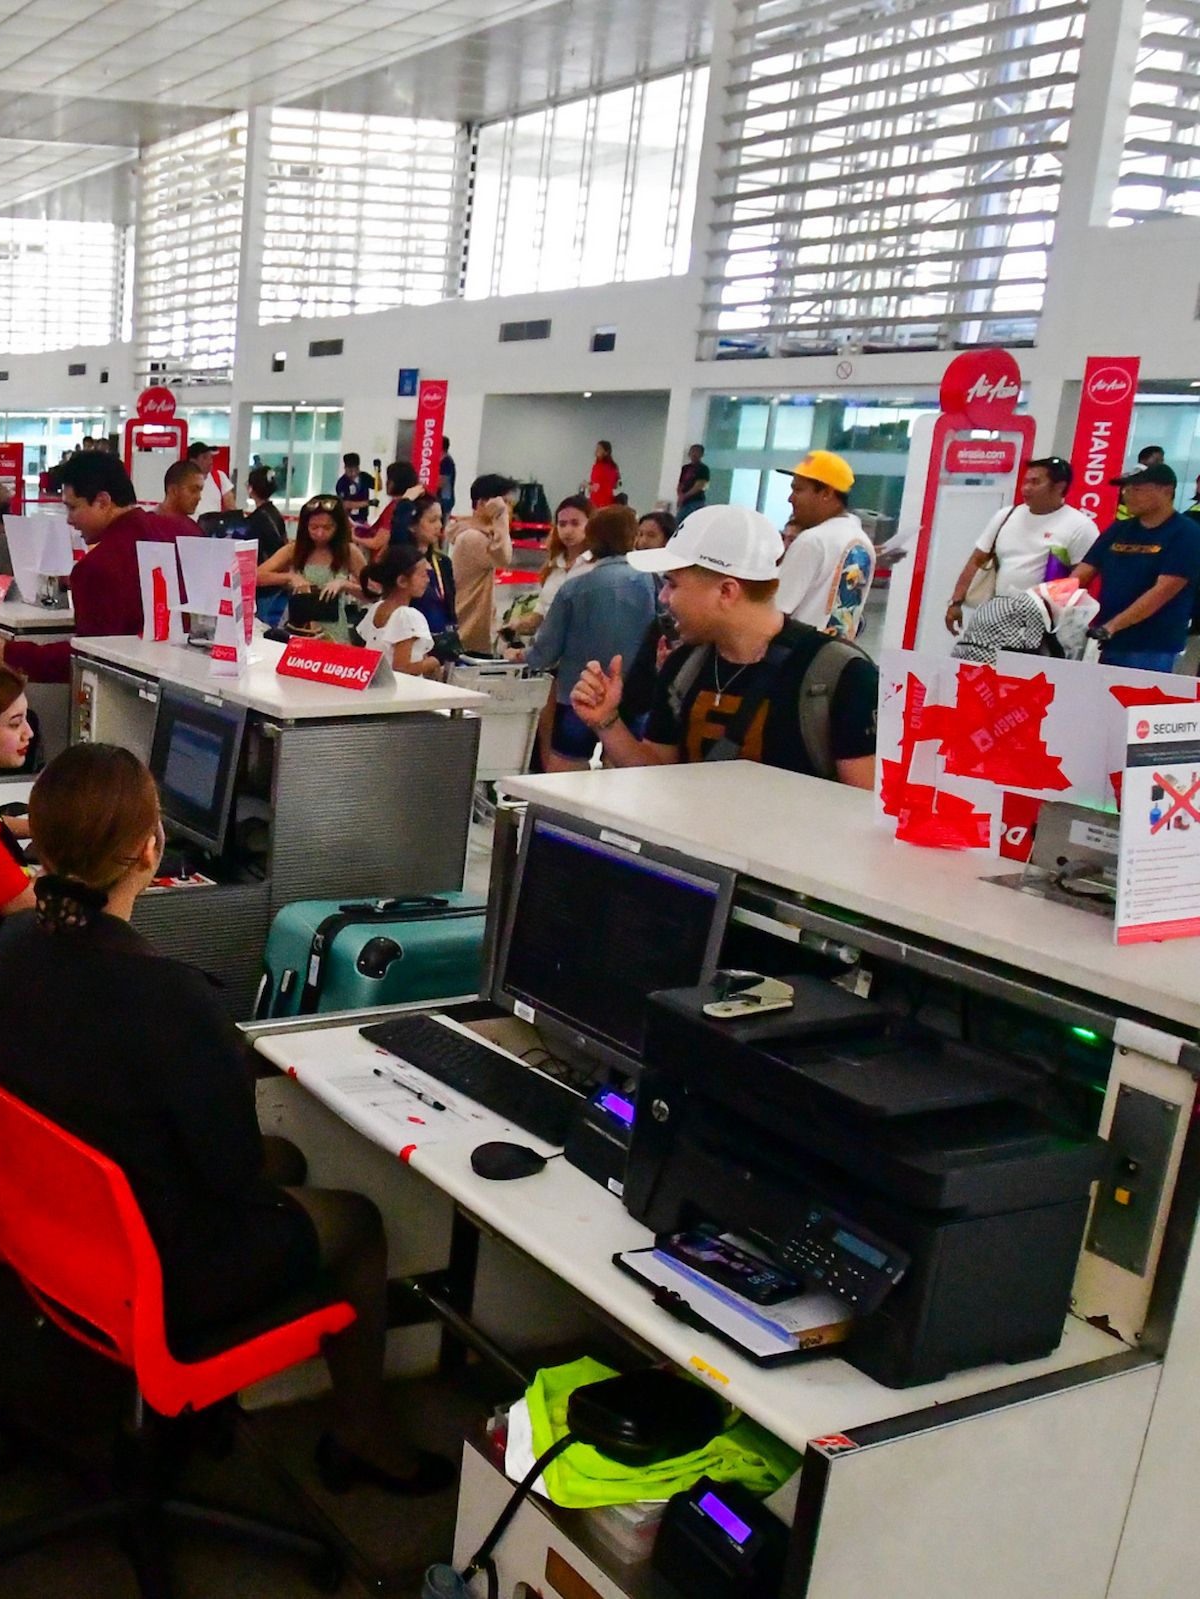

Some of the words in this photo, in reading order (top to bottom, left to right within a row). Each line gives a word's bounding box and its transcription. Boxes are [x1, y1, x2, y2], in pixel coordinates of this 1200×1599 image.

[1084, 421, 1113, 486] HAND
[286, 656, 322, 673] Down
[322, 662, 371, 683] System
[1153, 721, 1198, 735] SECURITY
